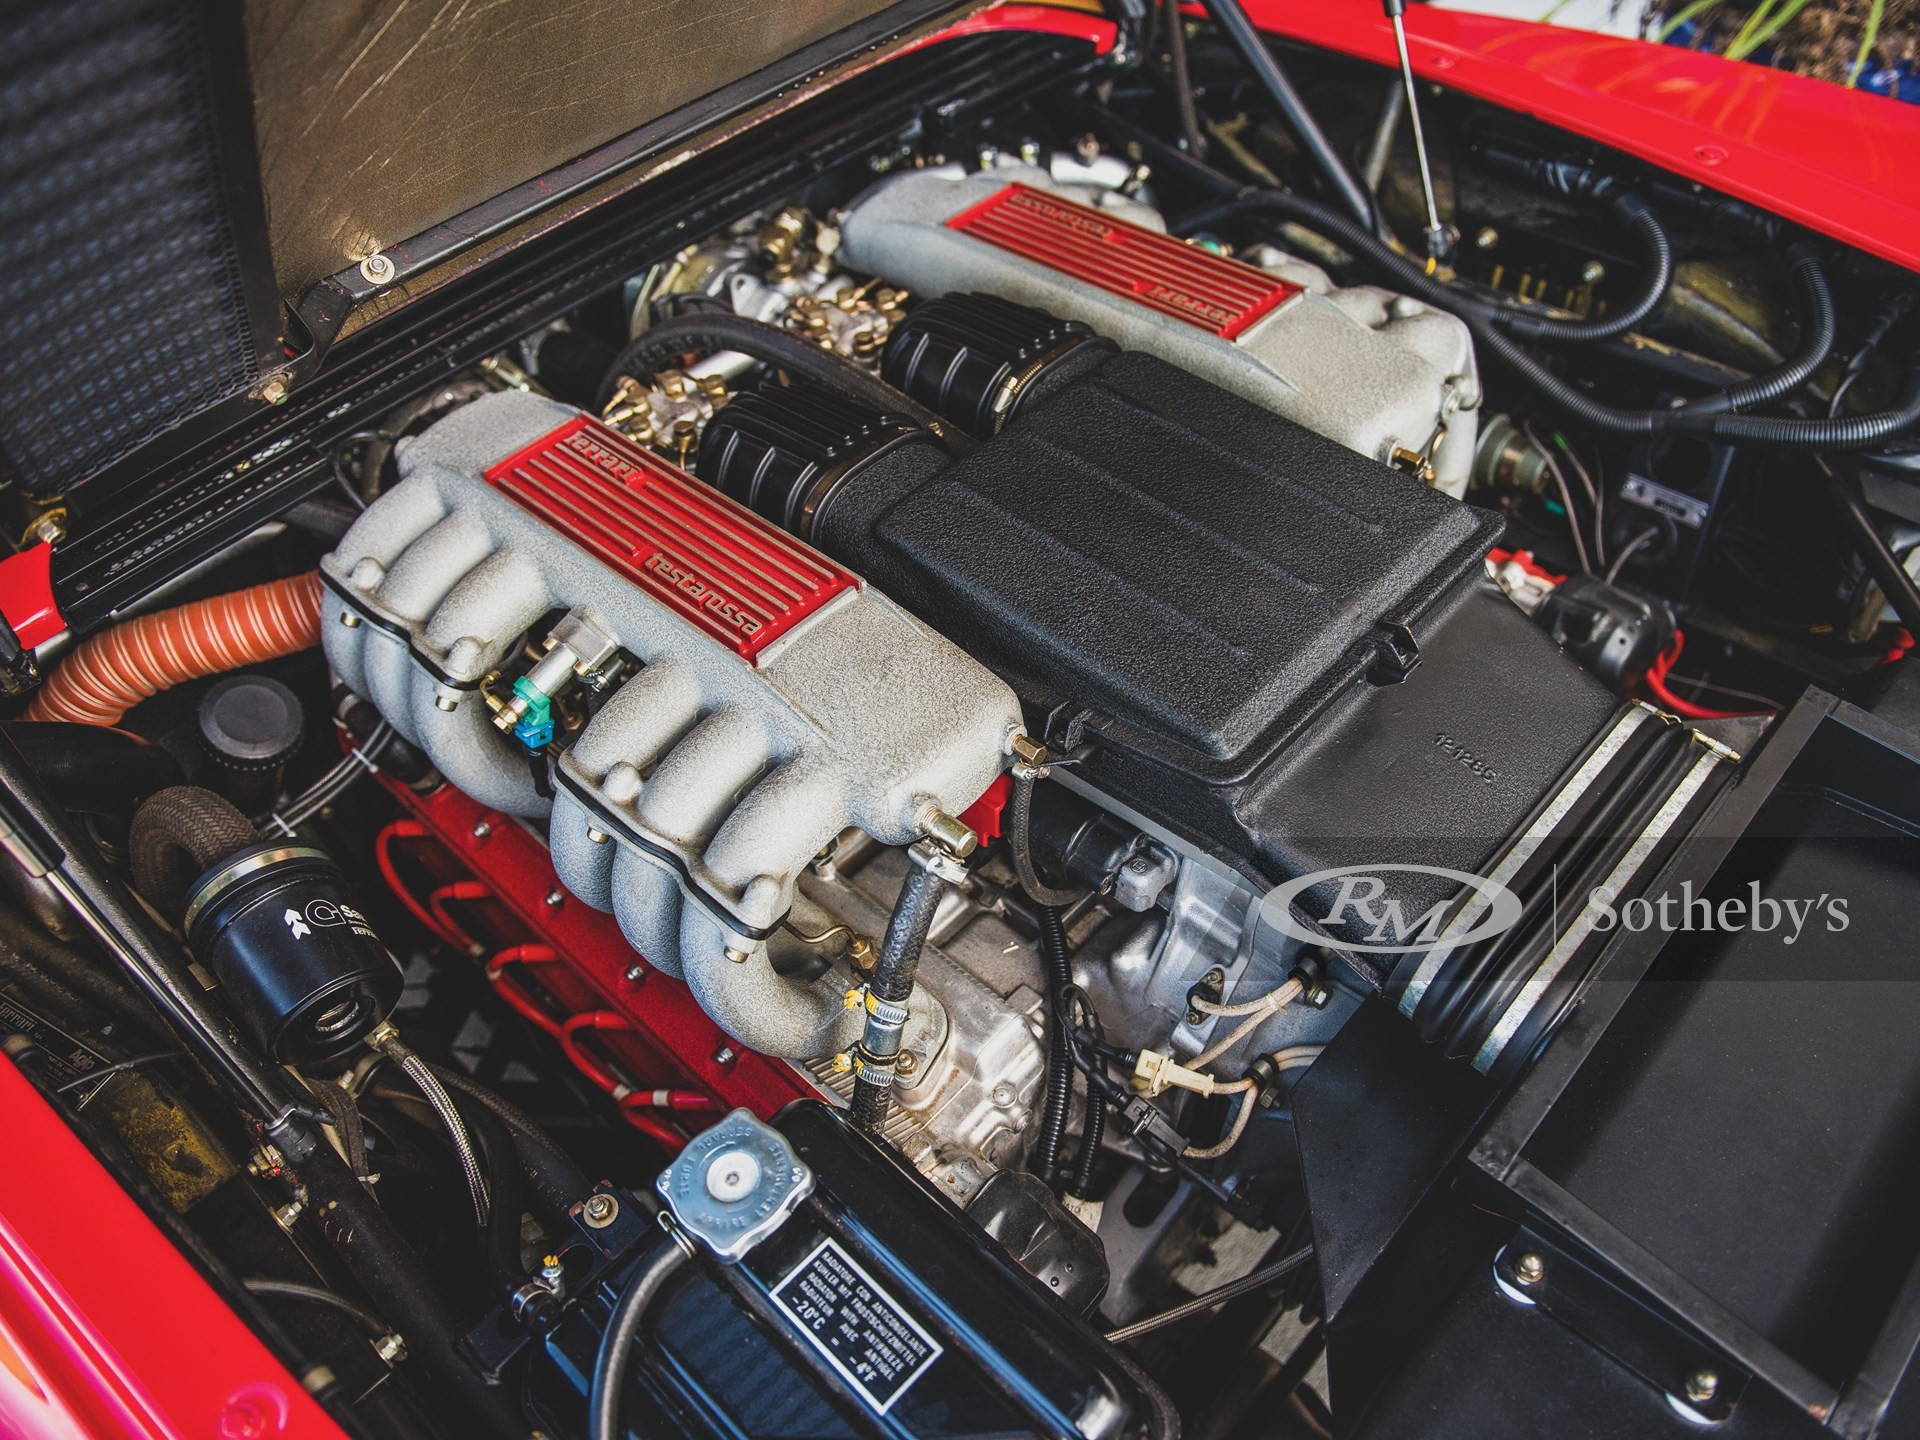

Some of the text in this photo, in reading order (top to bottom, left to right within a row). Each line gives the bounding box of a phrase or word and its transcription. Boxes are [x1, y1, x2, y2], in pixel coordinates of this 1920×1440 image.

[644, 552, 763, 637] testarossa
[799, 1279, 896, 1382] RADIATEUR AVEC ANTIGEL
[806, 1271, 905, 1373] RADIATOR WITH ANTIFREEZE
[821, 1250, 928, 1358] RADIATORE CON ANTICONGELANTE
[837, 1284, 852, 1299] MIT
[850, 1297, 918, 1367] FROSTSCHUTZMITTEL
